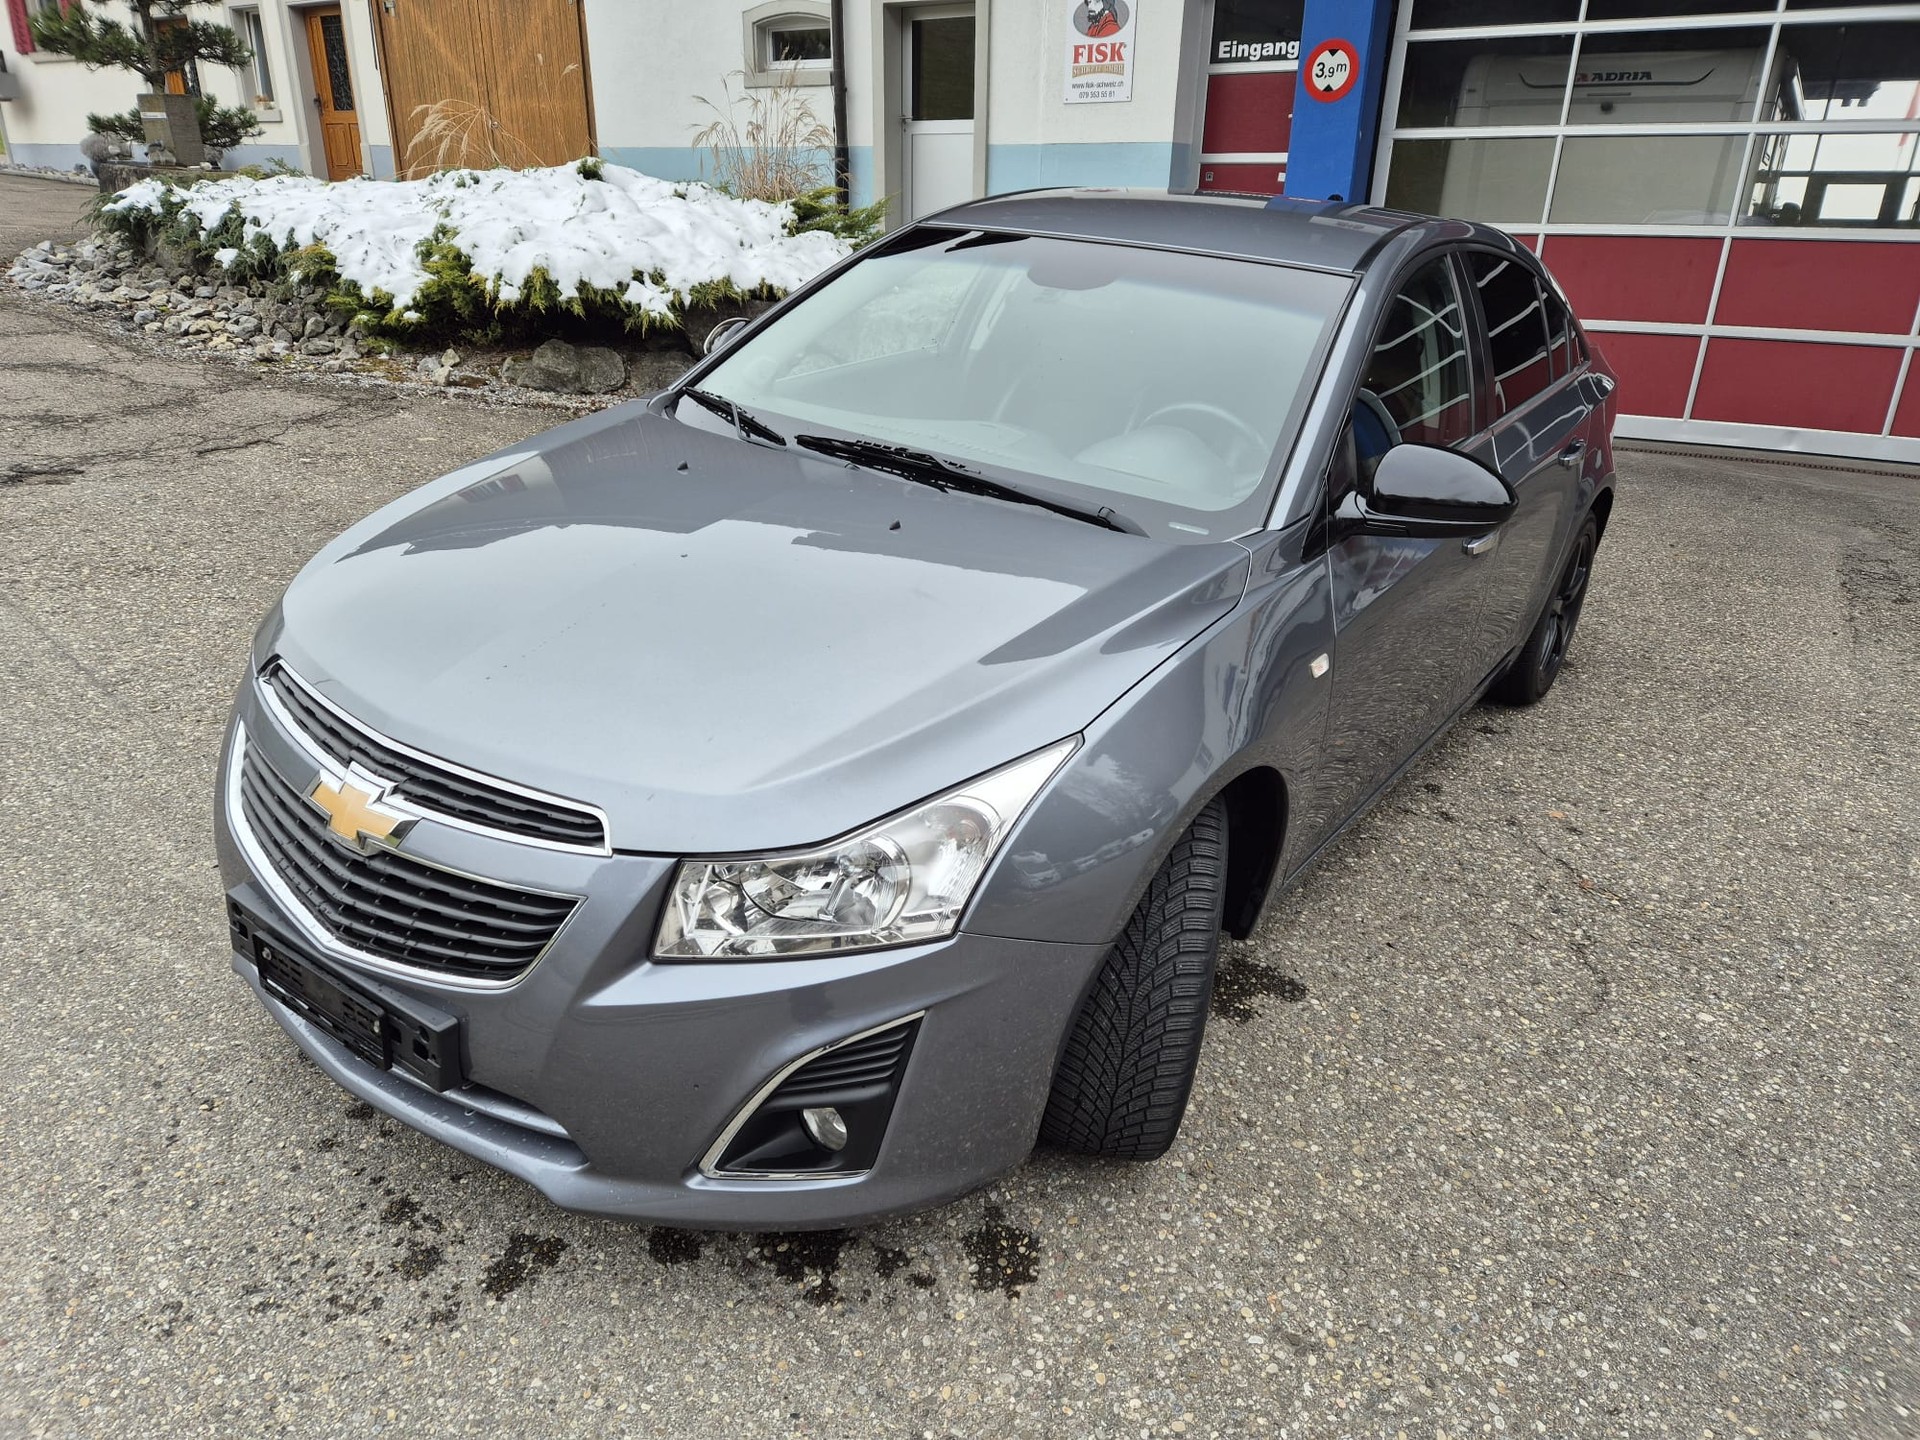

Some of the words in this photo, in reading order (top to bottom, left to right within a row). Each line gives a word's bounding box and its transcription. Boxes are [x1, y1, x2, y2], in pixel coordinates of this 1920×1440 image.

[1073, 42, 1126, 64] FISK
[1218, 40, 1300, 61] Eingang
[1591, 71, 1652, 82] ADRIA
